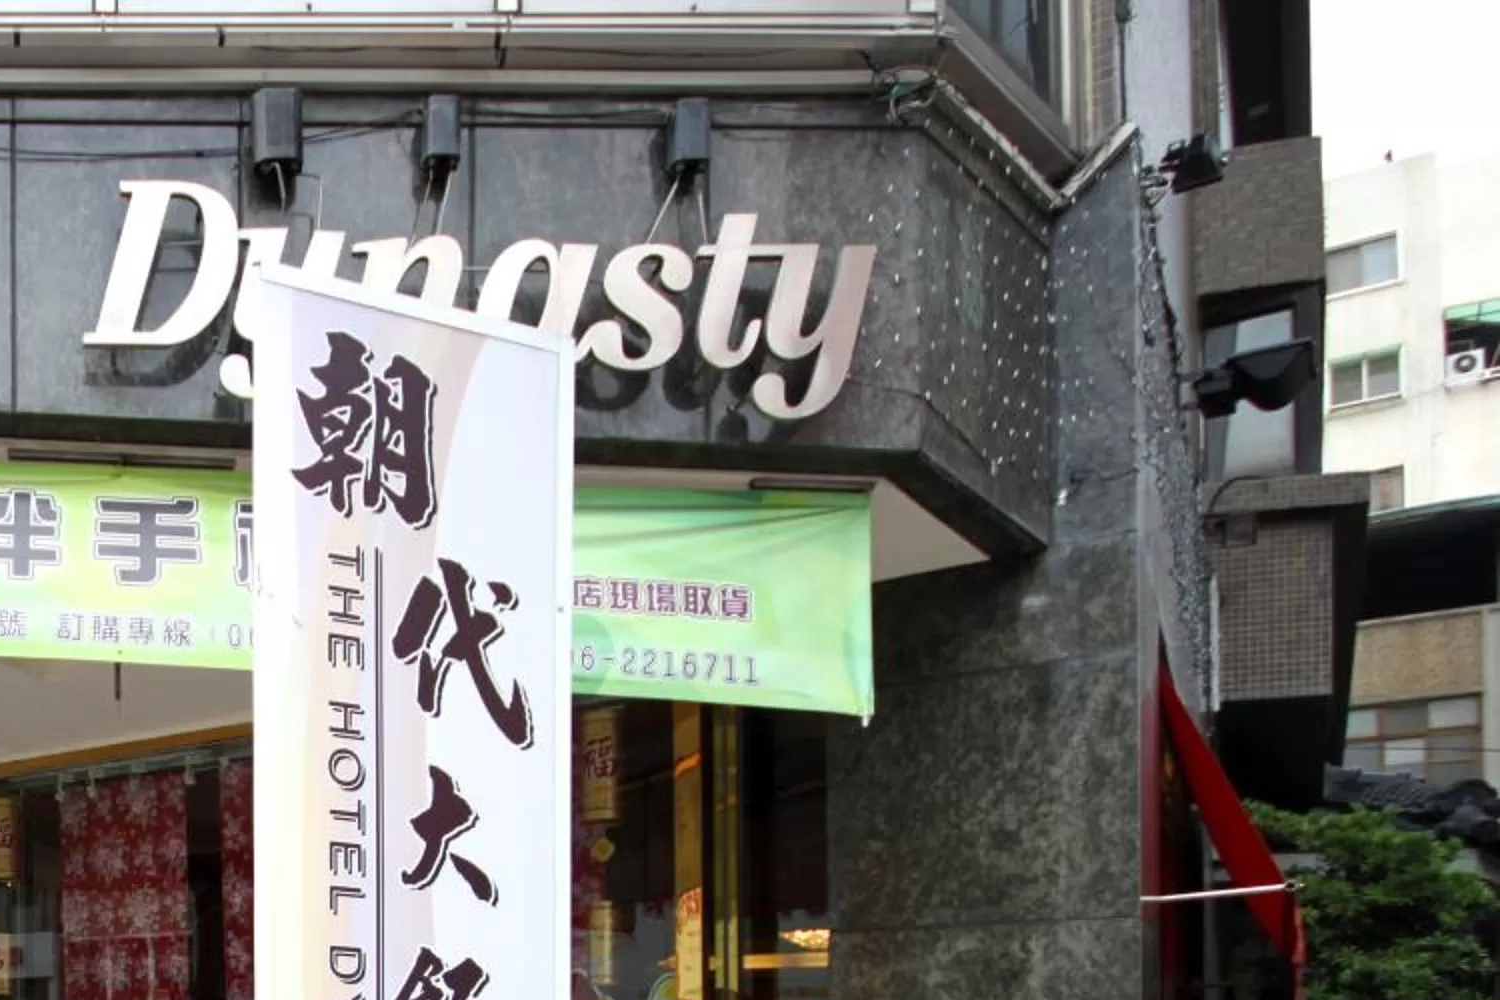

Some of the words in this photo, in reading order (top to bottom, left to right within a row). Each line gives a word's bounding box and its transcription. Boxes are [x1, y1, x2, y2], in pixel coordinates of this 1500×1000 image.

[83, 180, 878, 419] Dynasty
[328, 546, 366, 670] THE
[572, 646, 758, 685] 6-2216711
[328, 702, 366, 915] HOTEL
